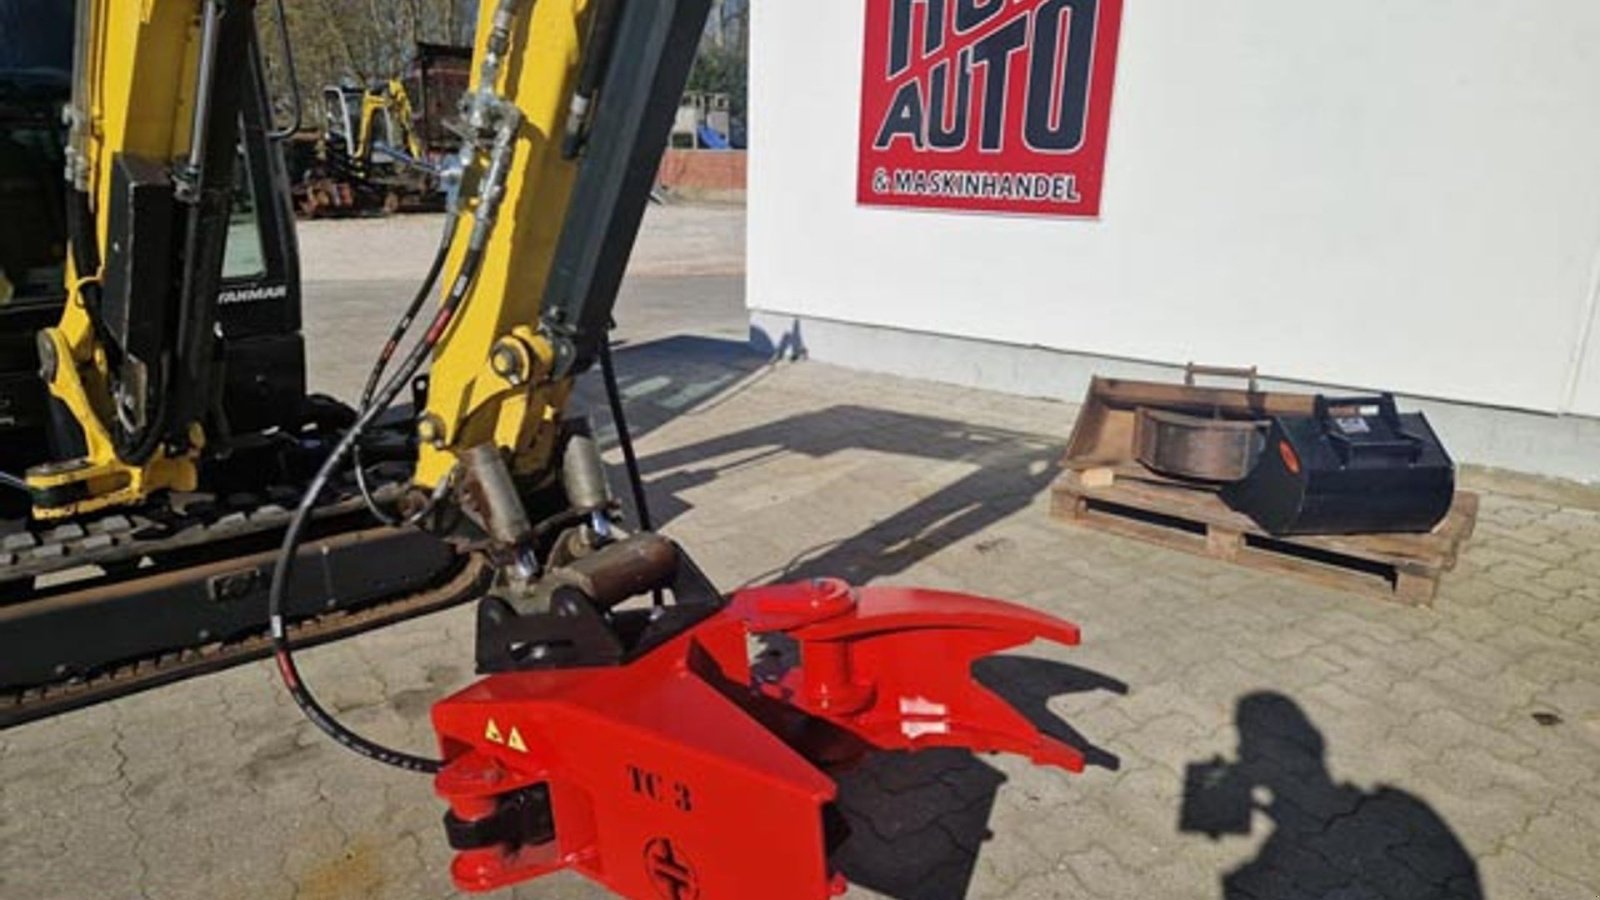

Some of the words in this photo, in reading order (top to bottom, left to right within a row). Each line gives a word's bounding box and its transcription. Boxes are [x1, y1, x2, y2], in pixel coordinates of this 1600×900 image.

[872, 0, 1098, 154] AUTO
[873, 167, 889, 193] &
[892, 169, 1081, 202] MASKINHANDEL
[626, 763, 662, 802] TC
[674, 781, 692, 811] 3
